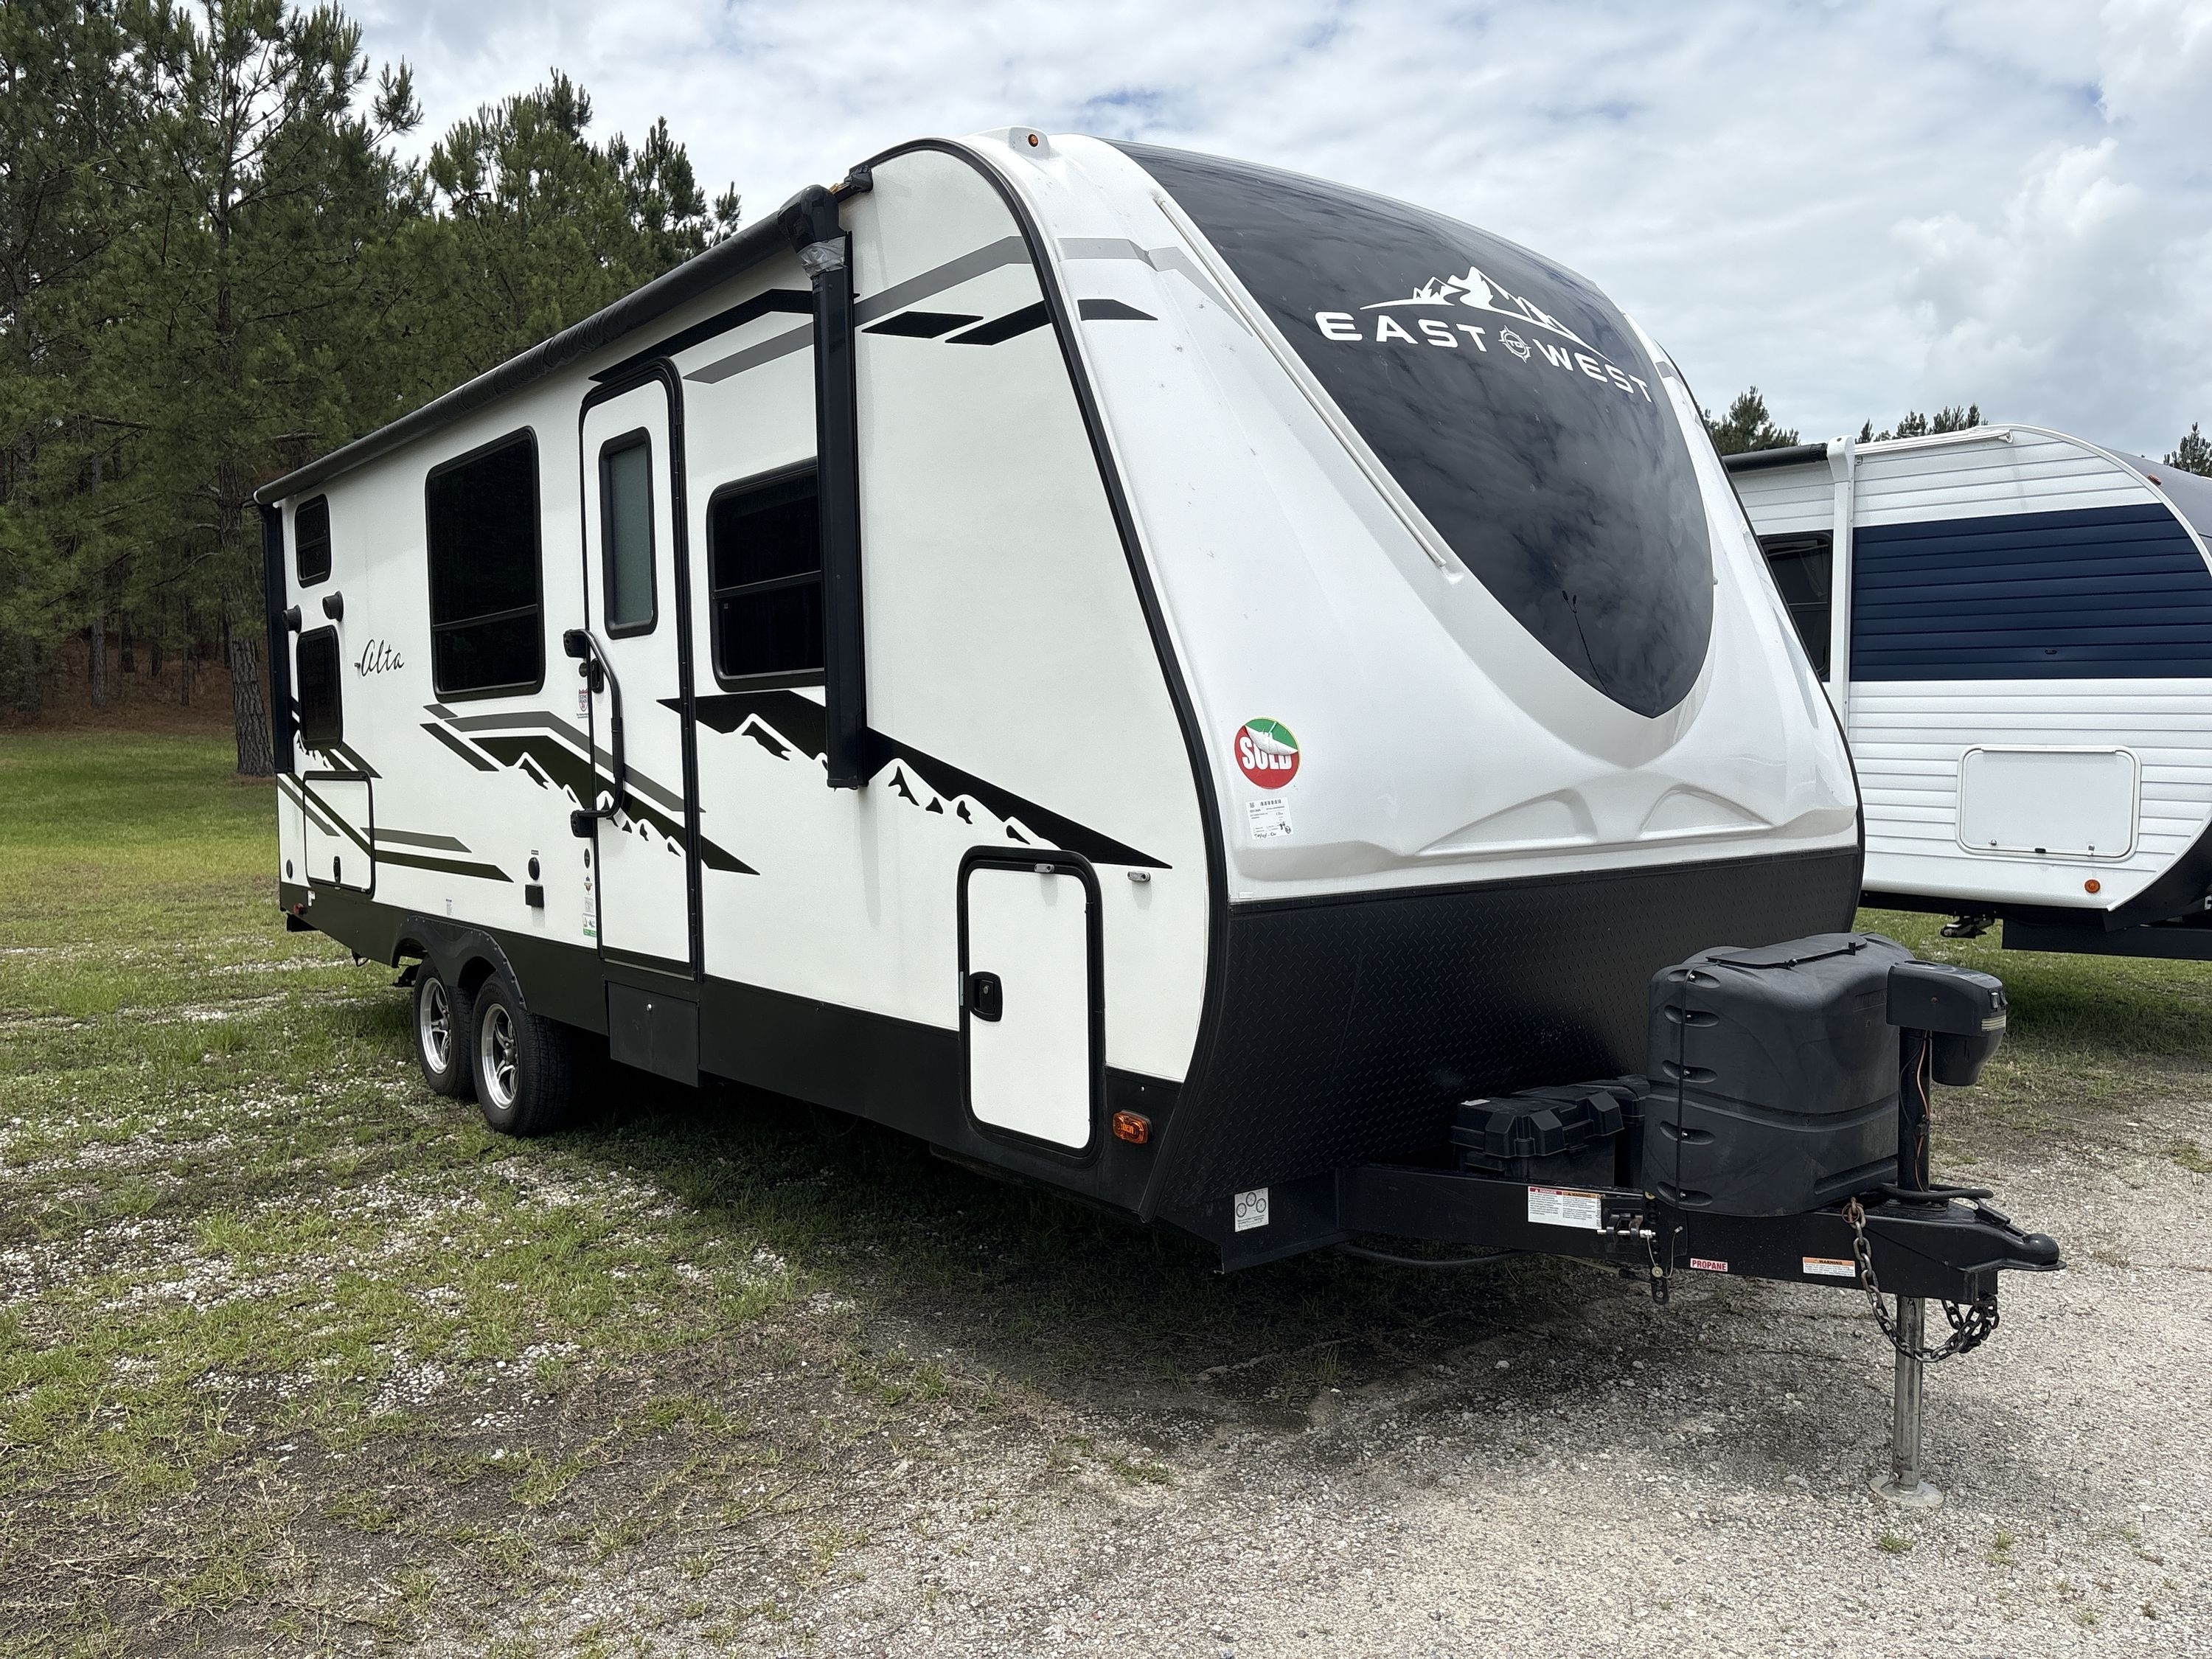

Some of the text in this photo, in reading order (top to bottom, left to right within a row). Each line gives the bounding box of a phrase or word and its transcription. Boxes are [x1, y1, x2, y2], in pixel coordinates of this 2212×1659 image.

[1315, 310, 1487, 352] EAST
[1531, 338, 1653, 403] WEST
[361, 639, 405, 677] Alta
[1692, 1259, 1727, 1271] PROPANE
